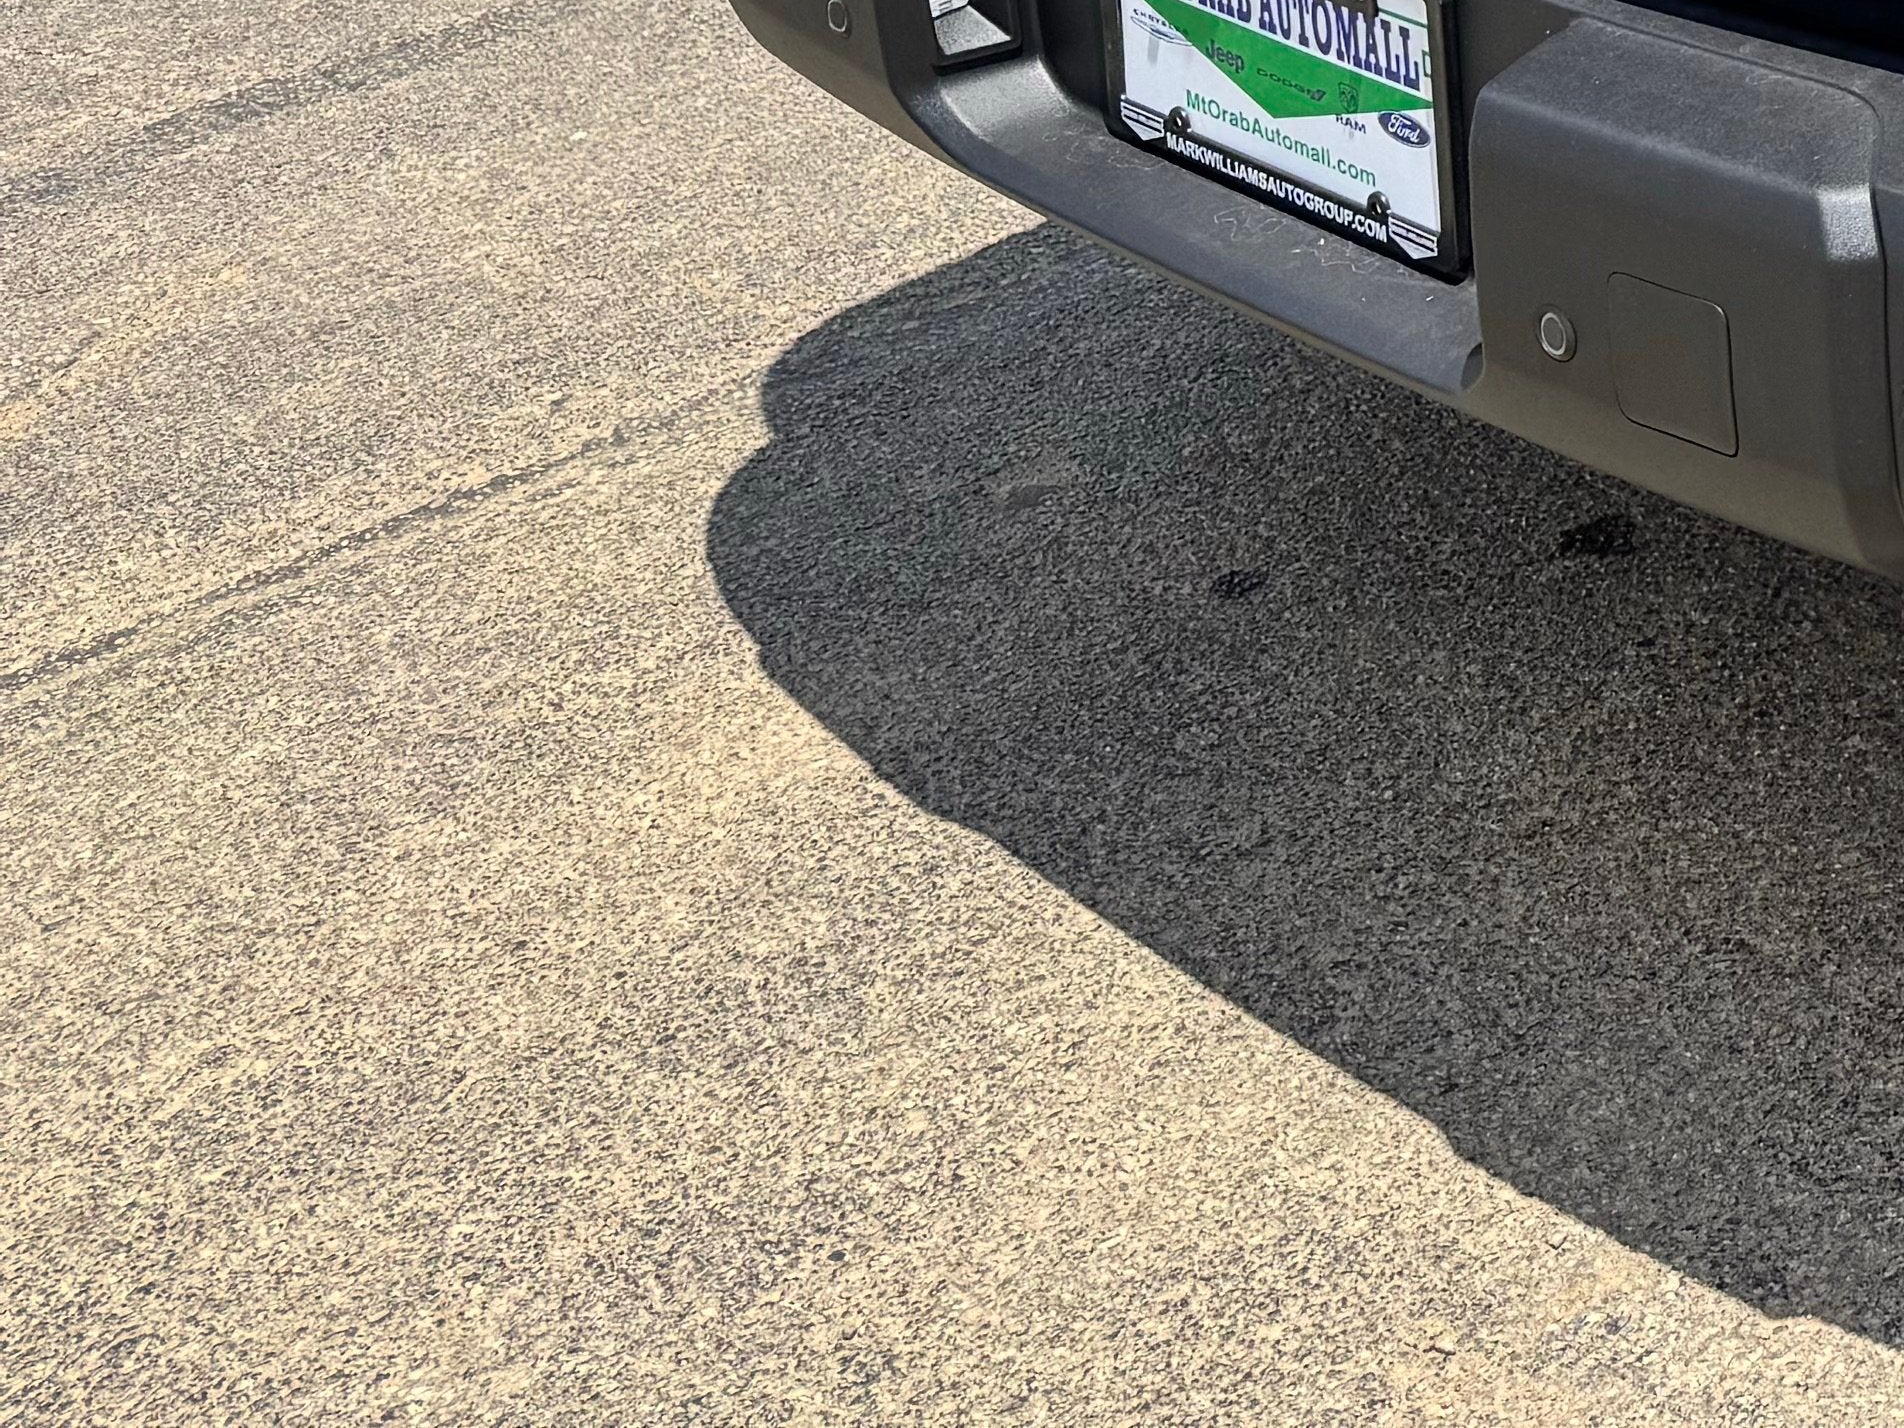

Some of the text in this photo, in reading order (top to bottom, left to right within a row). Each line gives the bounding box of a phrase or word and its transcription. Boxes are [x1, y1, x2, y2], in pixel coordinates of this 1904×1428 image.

[1205, 38, 1245, 74] Jeep
[1166, 131, 1388, 243] MARKWILLIAMSAUTOGROUP.COM
[1186, 89, 1376, 188] MtOrabAutomall.com
